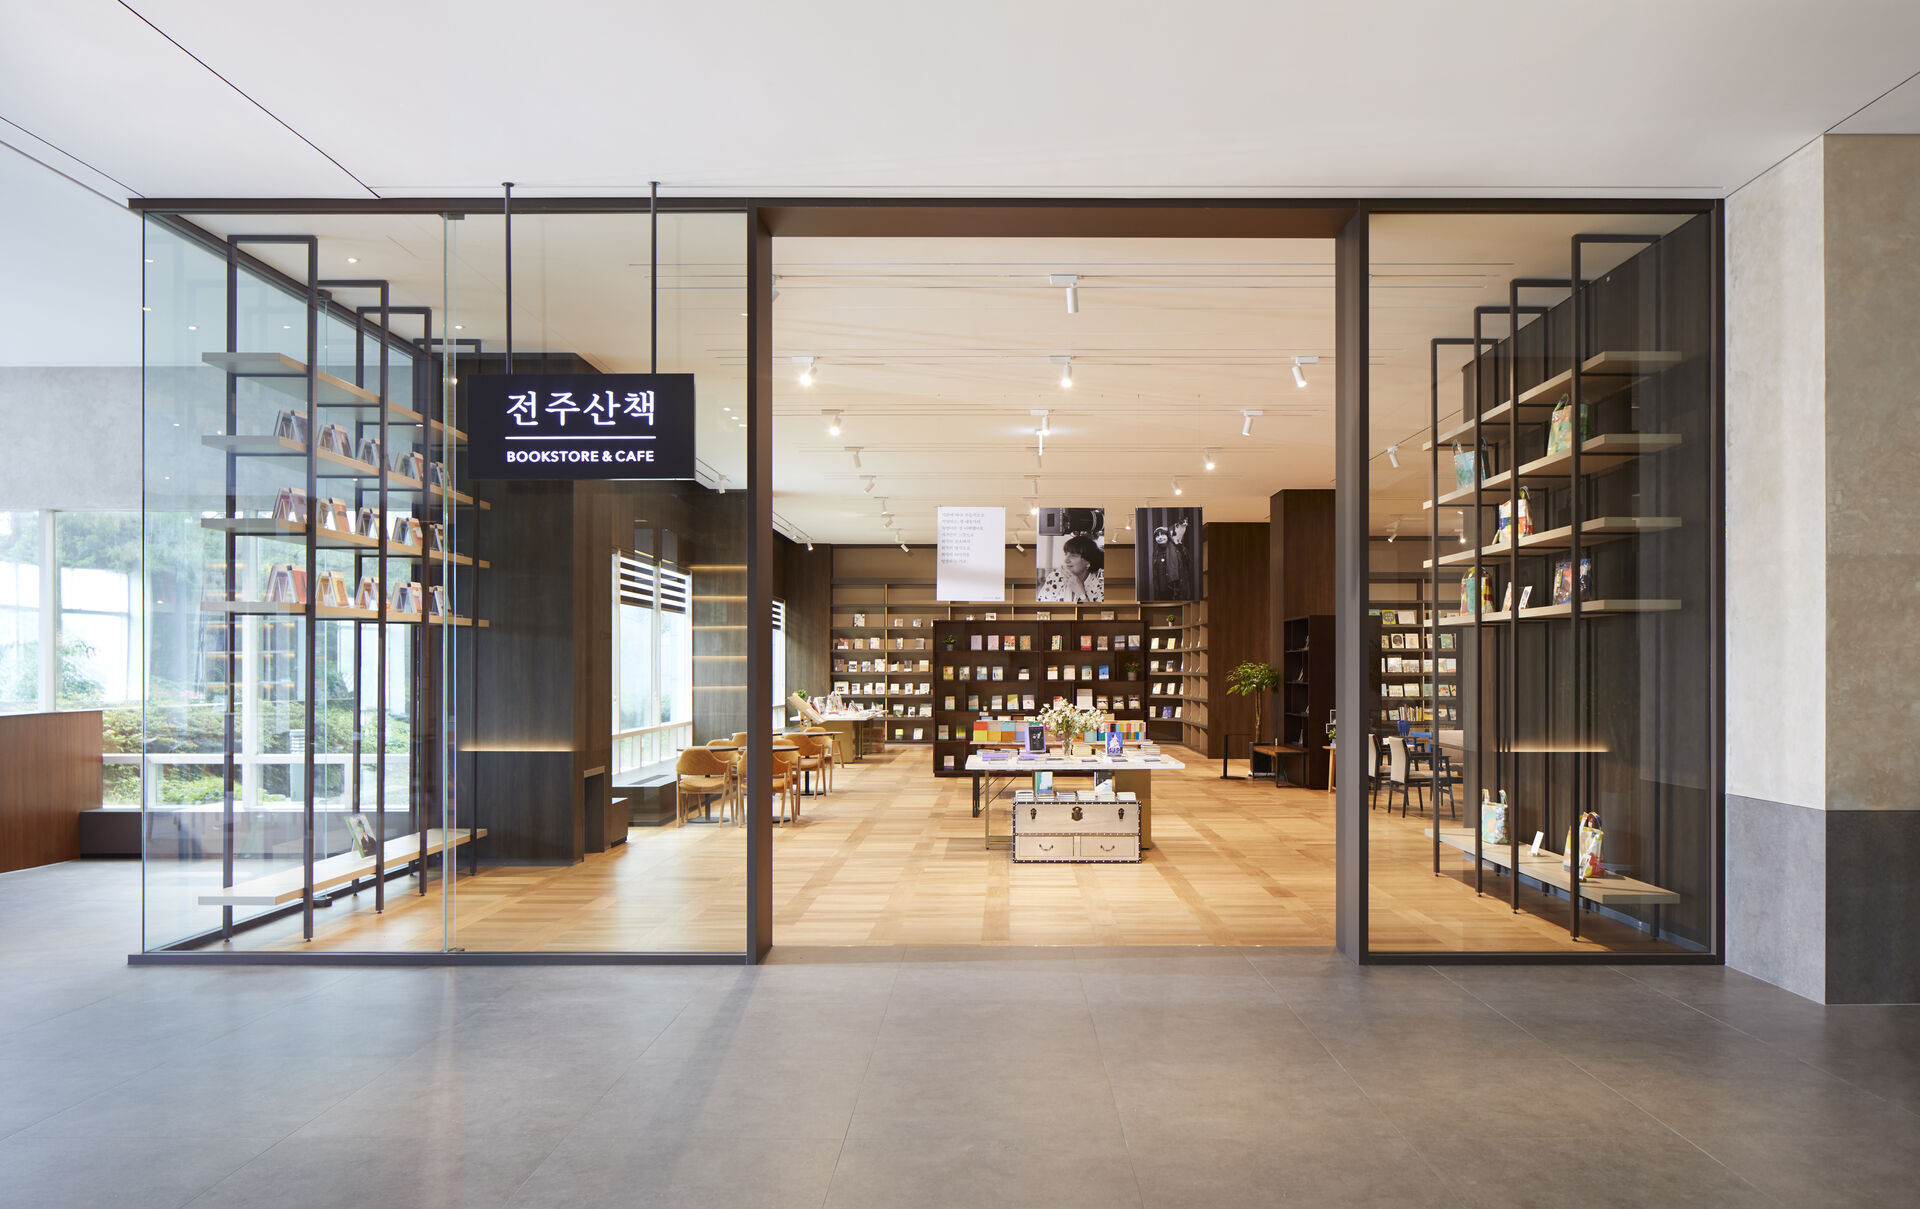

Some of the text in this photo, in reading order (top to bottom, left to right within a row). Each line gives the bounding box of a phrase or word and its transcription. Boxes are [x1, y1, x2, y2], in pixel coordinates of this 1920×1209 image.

[506, 390, 655, 427] 전주산책
[506, 450, 655, 463] BOOKSTORE & CAFE
